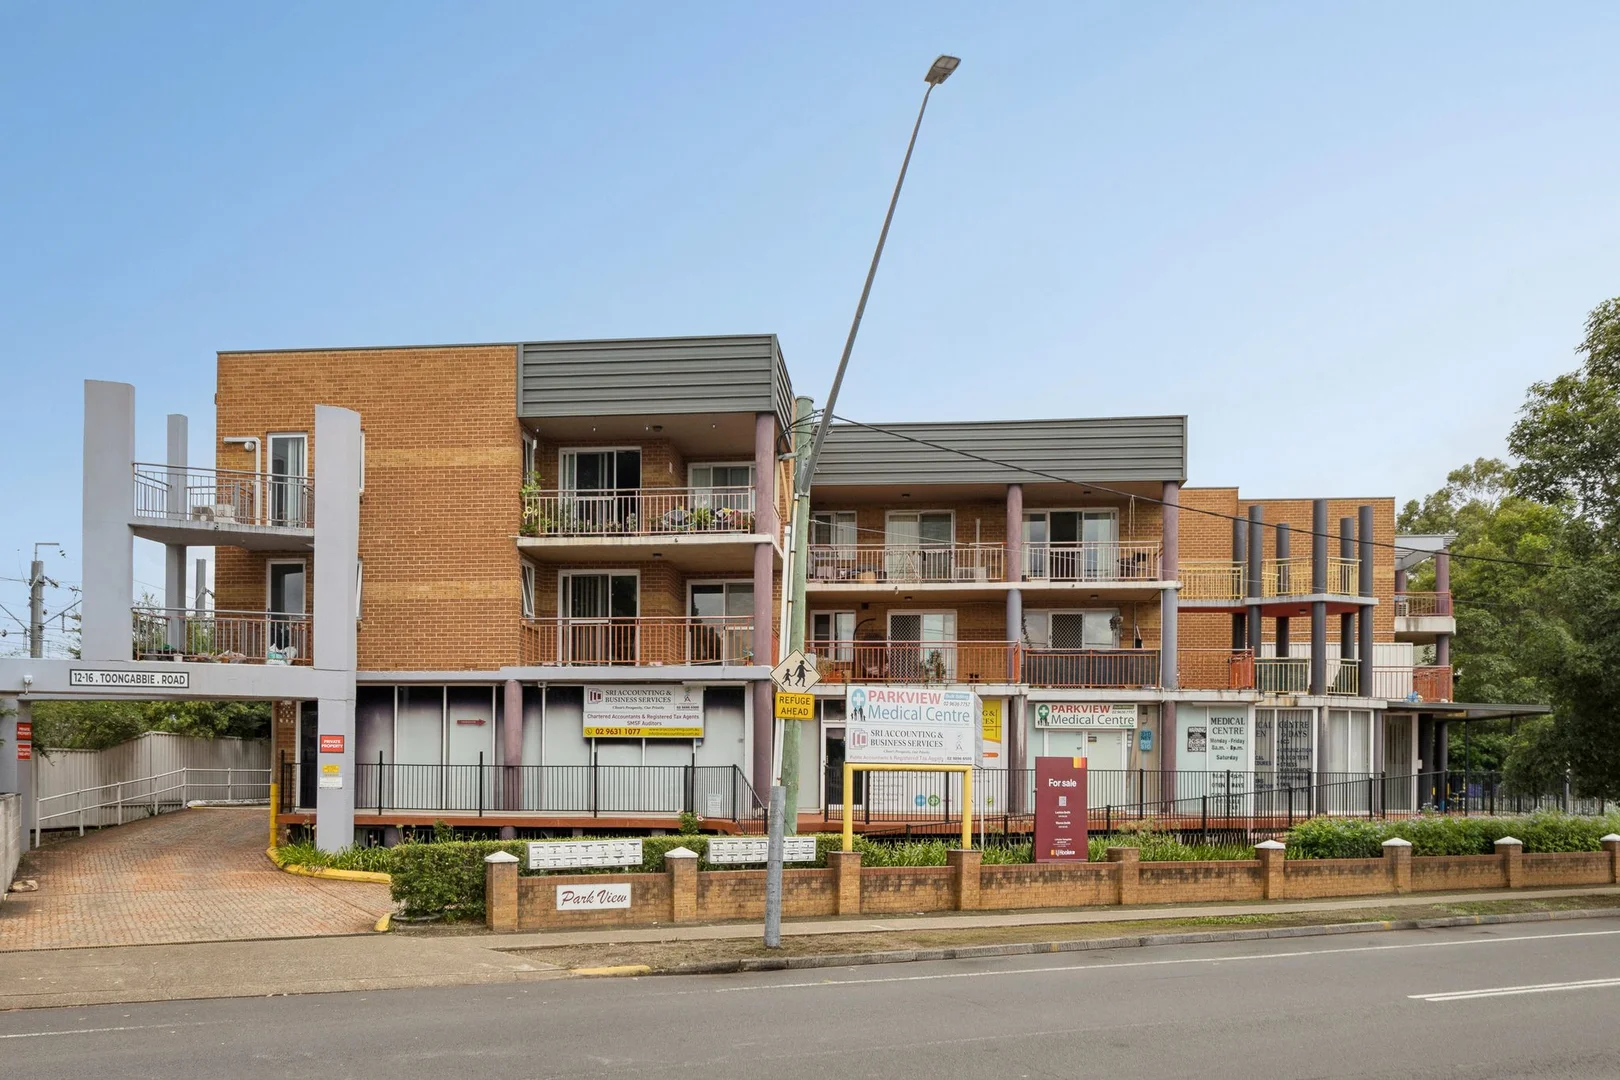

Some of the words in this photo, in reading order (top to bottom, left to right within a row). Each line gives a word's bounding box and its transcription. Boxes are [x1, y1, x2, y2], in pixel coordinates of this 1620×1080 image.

[74, 673, 93, 682] 12-16
[100, 673, 154, 684] TOONGABBIE
[162, 675, 185, 684] ROAD
[780, 696, 810, 705] REFUGE
[868, 690, 941, 704] PARKVIEW
[781, 707, 808, 715] AHEAD
[868, 705, 921, 720] Medical
[926, 707, 970, 722] Centre
[1051, 705, 1110, 713] PARKVIEW
[1051, 715, 1094, 725] Medical
[1098, 715, 1134, 725] Centre
[1210, 717, 1245, 725] MEDICAL
[1048, 779, 1061, 787] For
[1062, 779, 1077, 787] sale
[561, 890, 594, 906] Park
[597, 889, 627, 904] View
